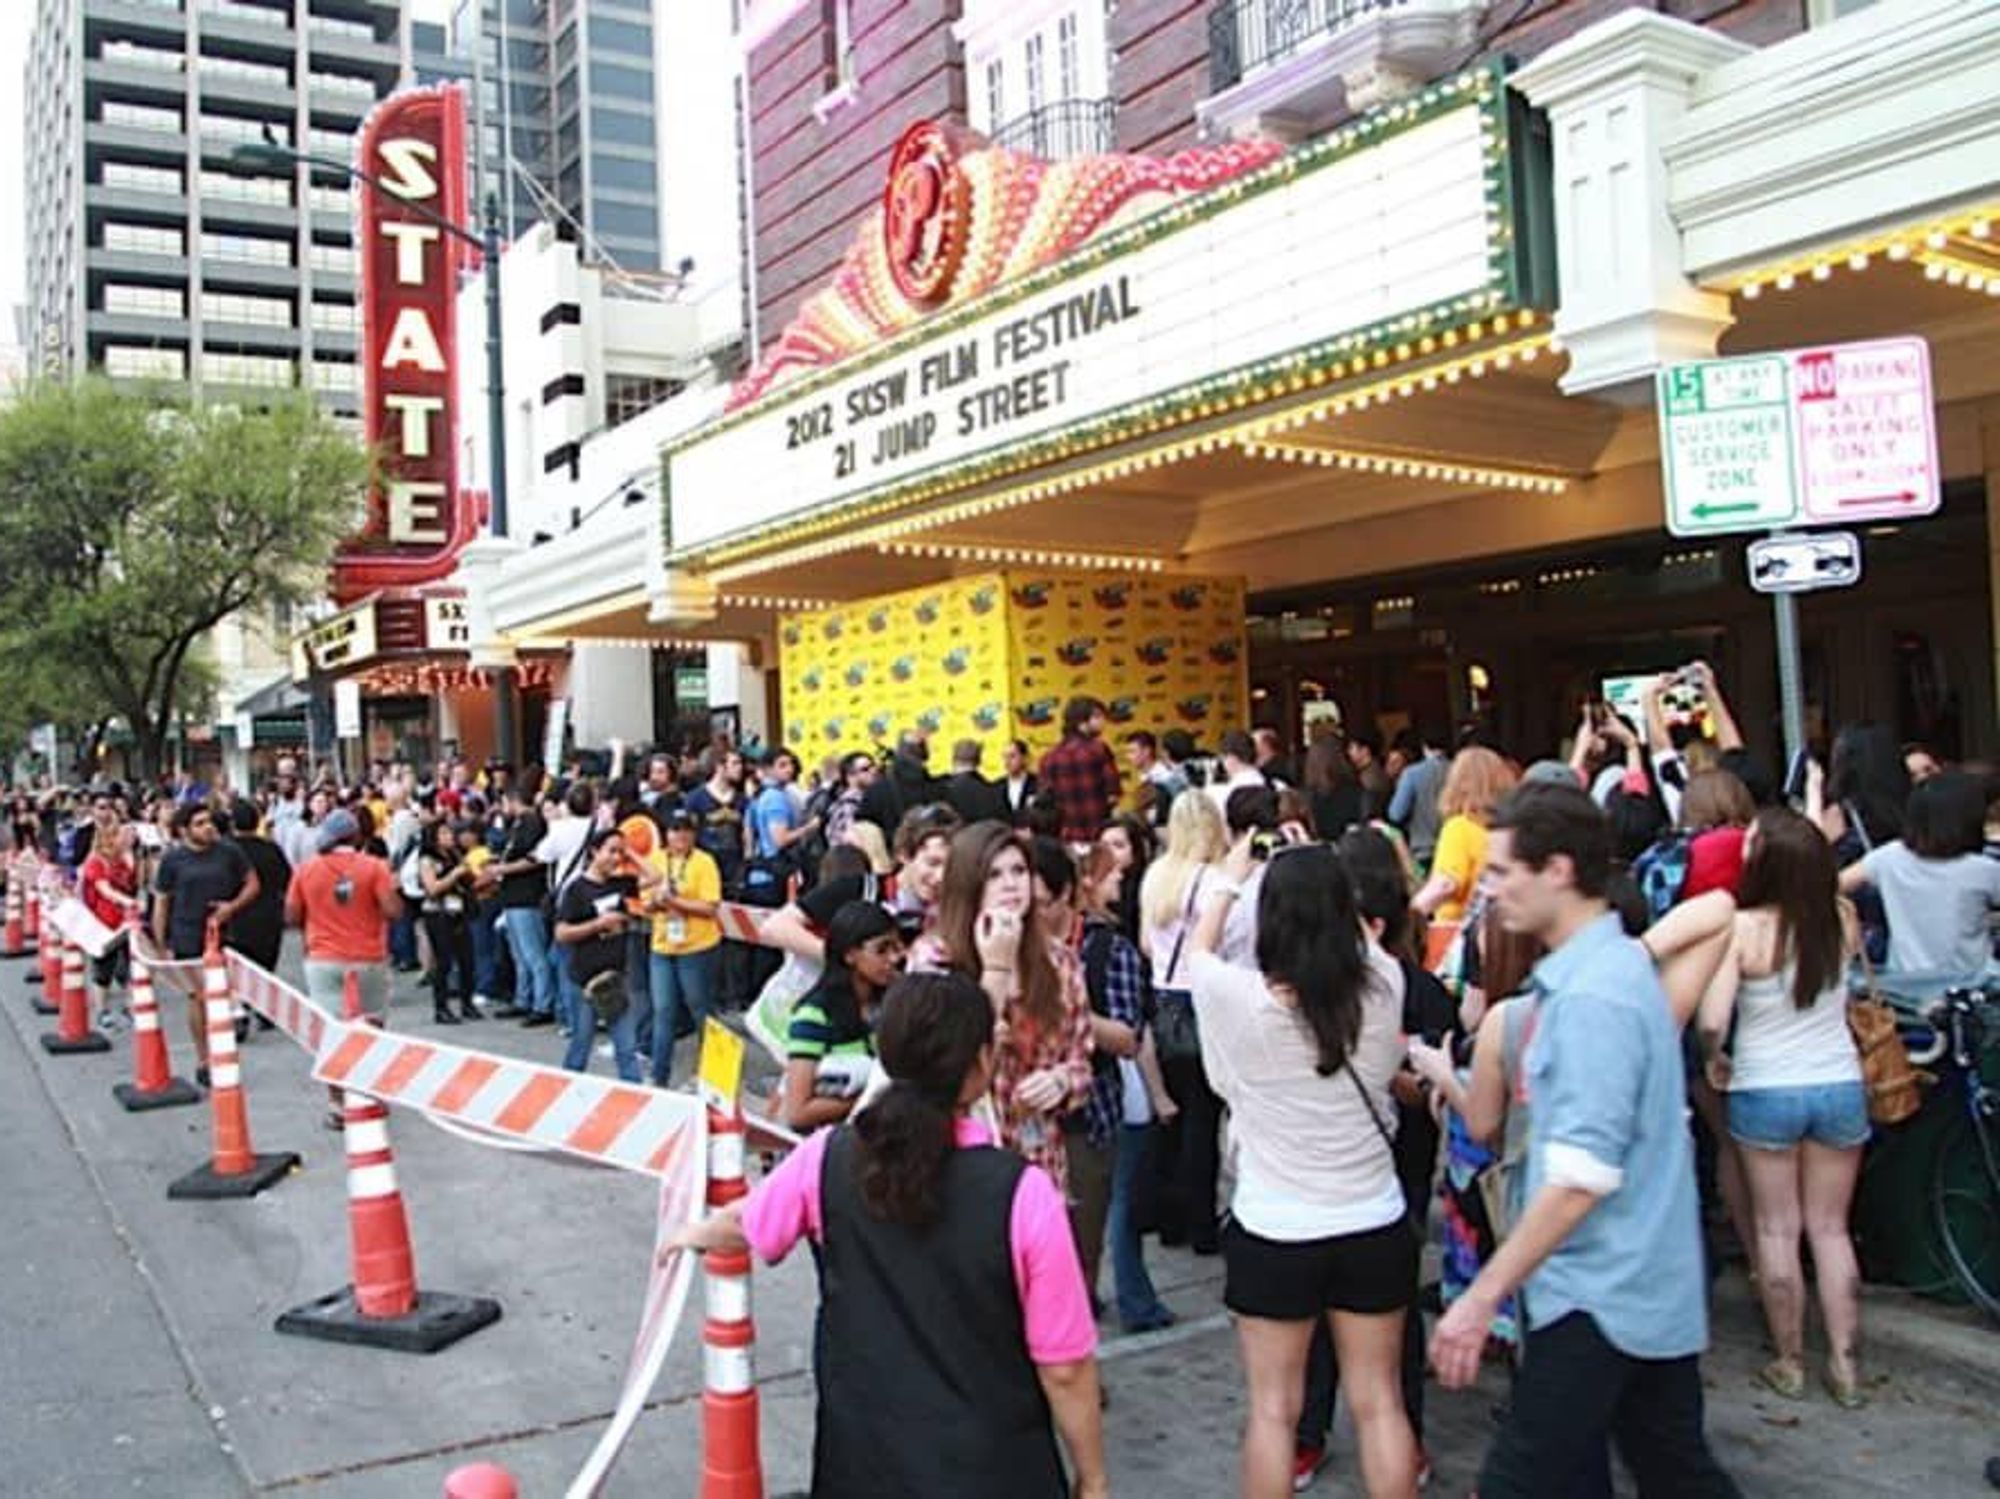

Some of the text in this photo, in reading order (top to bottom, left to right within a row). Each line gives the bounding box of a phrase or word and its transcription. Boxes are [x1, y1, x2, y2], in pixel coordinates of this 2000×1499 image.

[378, 138, 447, 545] STATE
[786, 275, 1141, 450] 2012 SXSW FILM FESTIVAL
[834, 359, 1071, 479] 21 JUMP STREET
[1676, 413, 1780, 446] CUSTOMER
[1689, 440, 1771, 467] SERVICE
[1832, 437, 1896, 462] ONLY
[1706, 467, 1758, 492] ZONE
